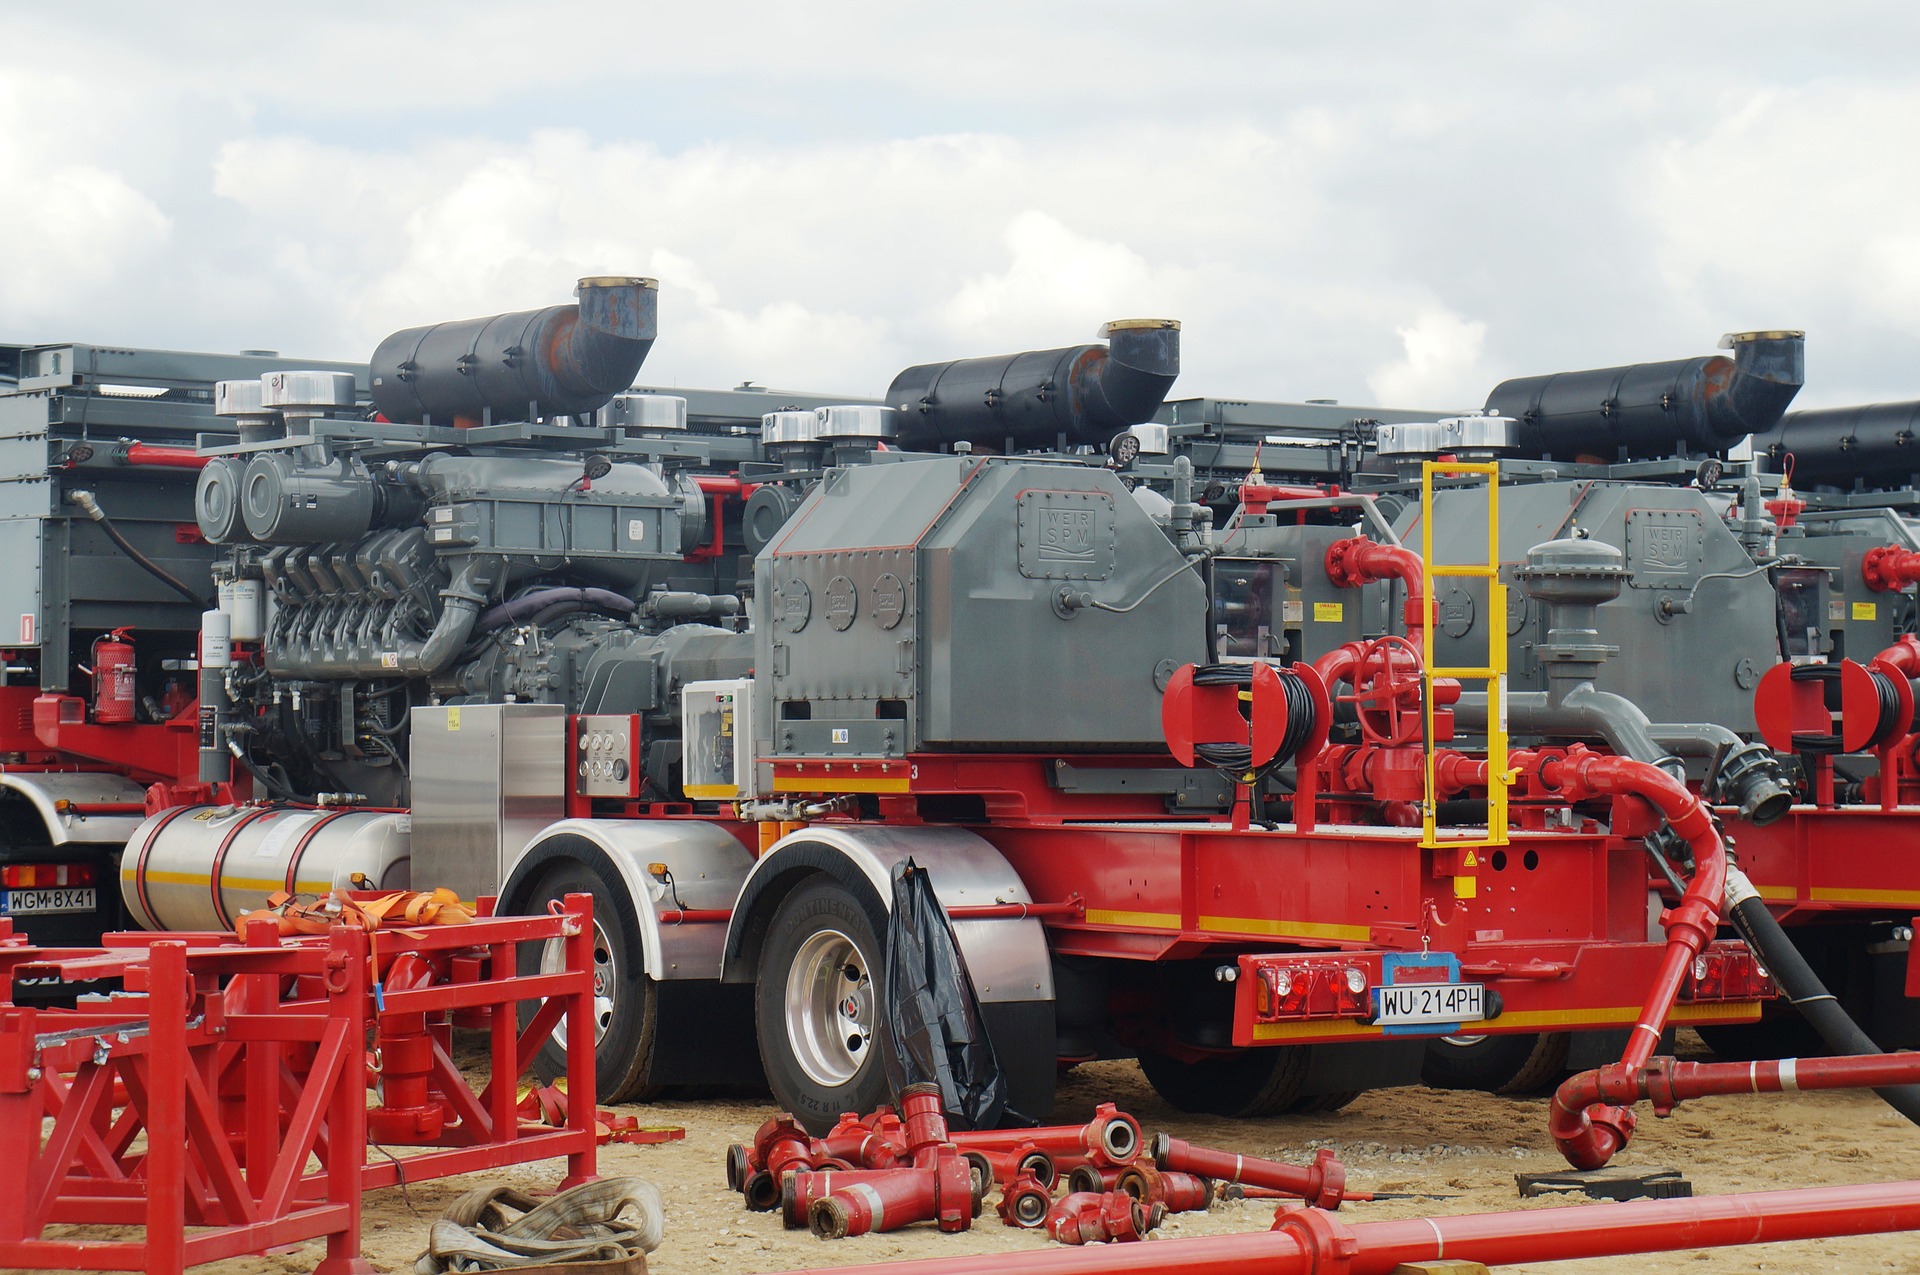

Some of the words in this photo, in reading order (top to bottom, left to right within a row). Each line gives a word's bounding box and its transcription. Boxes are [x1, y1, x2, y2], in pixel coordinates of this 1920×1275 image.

[1048, 513, 1088, 526] WEIR
[1047, 528, 1088, 546] SPM
[1649, 529, 1682, 541] WEIR
[1650, 543, 1682, 559] SPM
[911, 764, 918, 779] 3
[12, 892, 48, 909] WGM
[54, 890, 92, 907] 8X41
[1384, 991, 1413, 1015] WU
[1421, 988, 1479, 1014] 214PH
